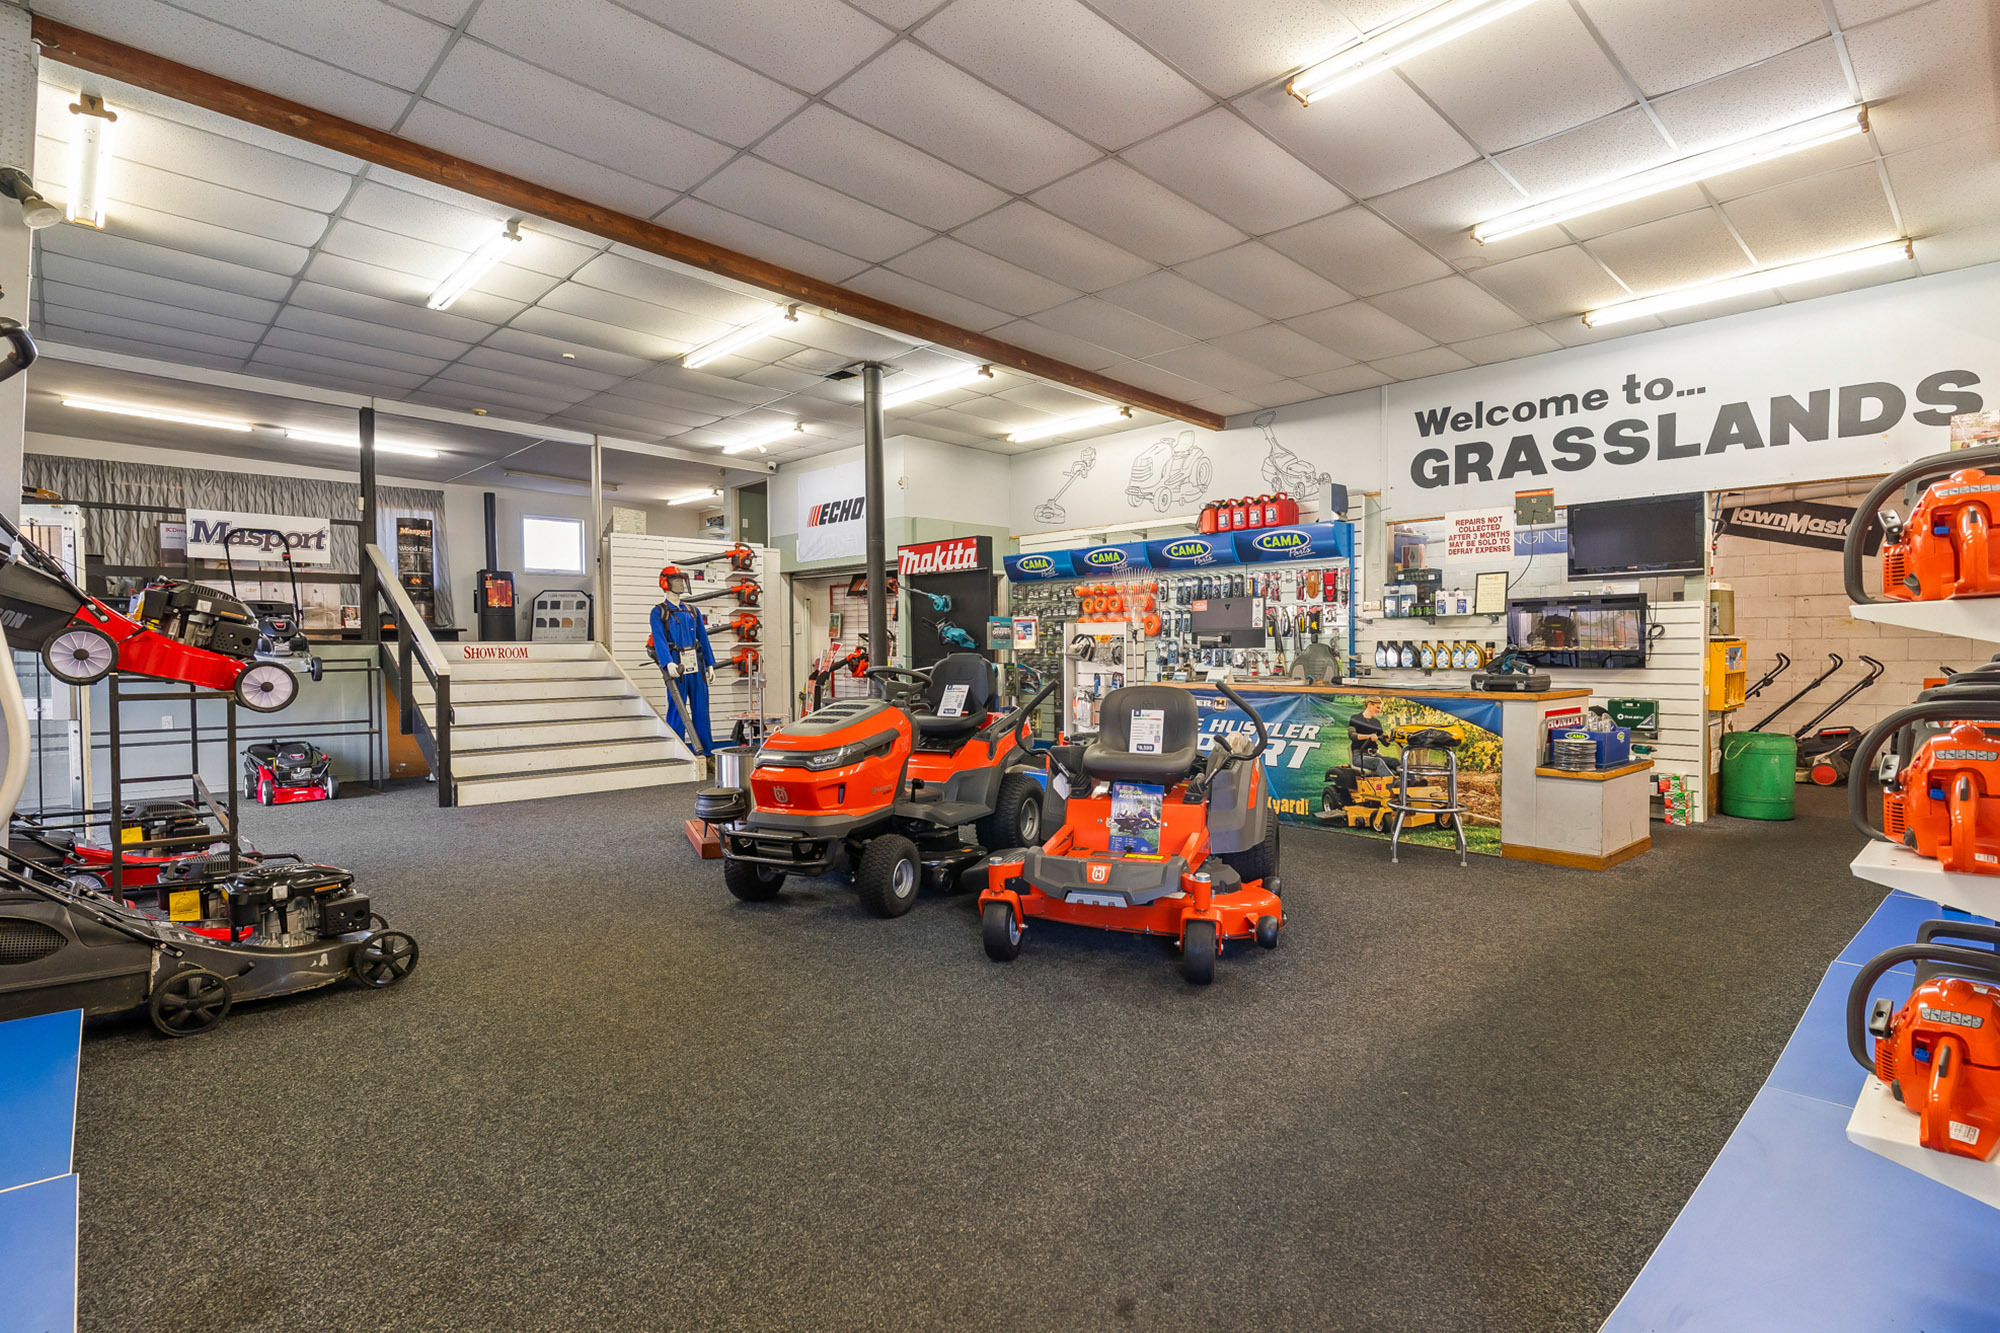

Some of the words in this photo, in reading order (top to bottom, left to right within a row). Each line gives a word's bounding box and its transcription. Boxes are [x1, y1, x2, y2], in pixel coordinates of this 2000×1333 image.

[1415, 385, 1608, 438] Welcome
[1623, 373, 1706, 405] to...
[1410, 369, 1984, 489] GRASSLANDS
[819, 497, 865, 525] ECHO
[1455, 517, 1486, 526] REPAIRS
[1487, 516, 1503, 525] NOT
[1730, 507, 1872, 534] LawnMast
[1458, 524, 1501, 533] COLLECTED
[1479, 530, 1511, 539] MONTHS
[189, 519, 327, 553] Masport
[1263, 533, 1302, 548] CAMA
[1500, 537, 1510, 545] TO
[1171, 544, 1205, 557] CAMA
[1448, 547, 1473, 555] DEFRAY
[1475, 545, 1511, 553] EXPENSES
[1023, 558, 1049, 570] CAMA
[1091, 551, 1121, 564] CAMA
[464, 645, 529, 660] SHOWROOM
[1208, 718, 1321, 740] HUSTLER
